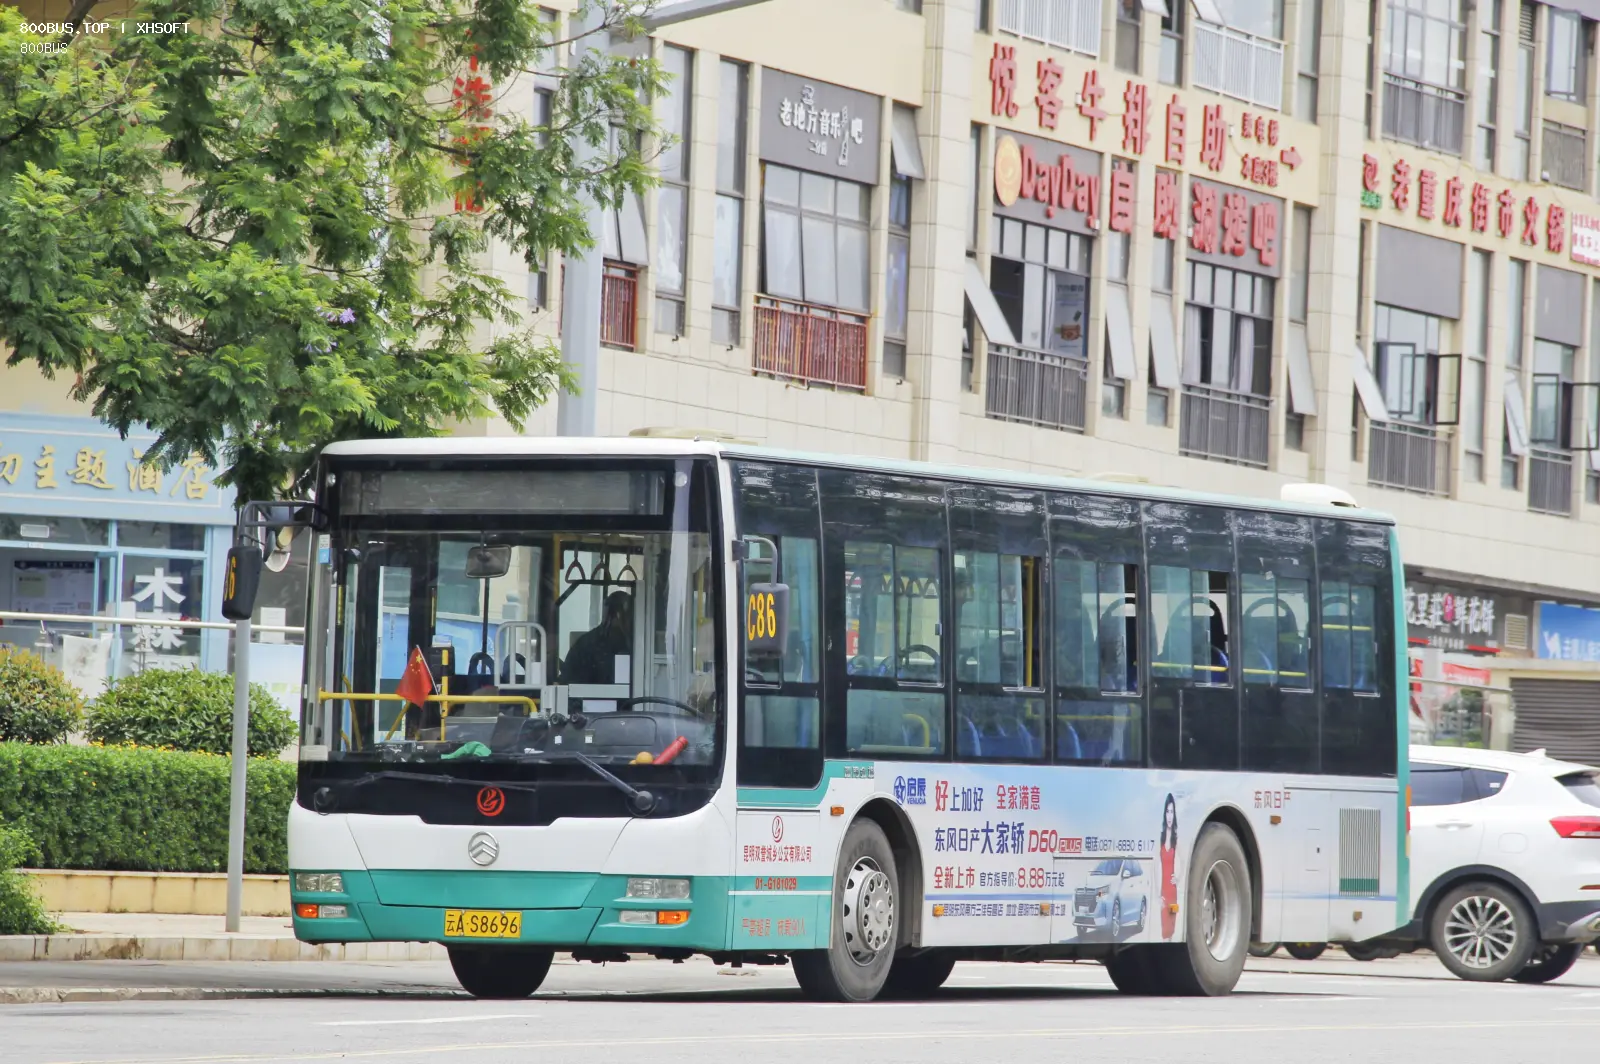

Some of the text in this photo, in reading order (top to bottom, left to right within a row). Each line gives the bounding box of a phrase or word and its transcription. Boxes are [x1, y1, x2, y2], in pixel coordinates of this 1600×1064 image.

[780, 97, 863, 145] 老地方音乐吧
[989, 43, 1227, 171] 悦客牛排自助
[1020, 145, 1100, 229] DayDay
[1391, 159, 1565, 253] 老重庆街市火锅
[747, 592, 776, 641] C86
[907, 777, 926, 797] 启辰
[935, 780, 1041, 812] 好上加好 全家满意
[1254, 790, 1291, 809] 东风日产
[934, 821, 1025, 855] 东风日产大家轿
[1027, 829, 1058, 853] D60
[755, 877, 798, 891] 01-G181029
[934, 866, 975, 889] 全新上市
